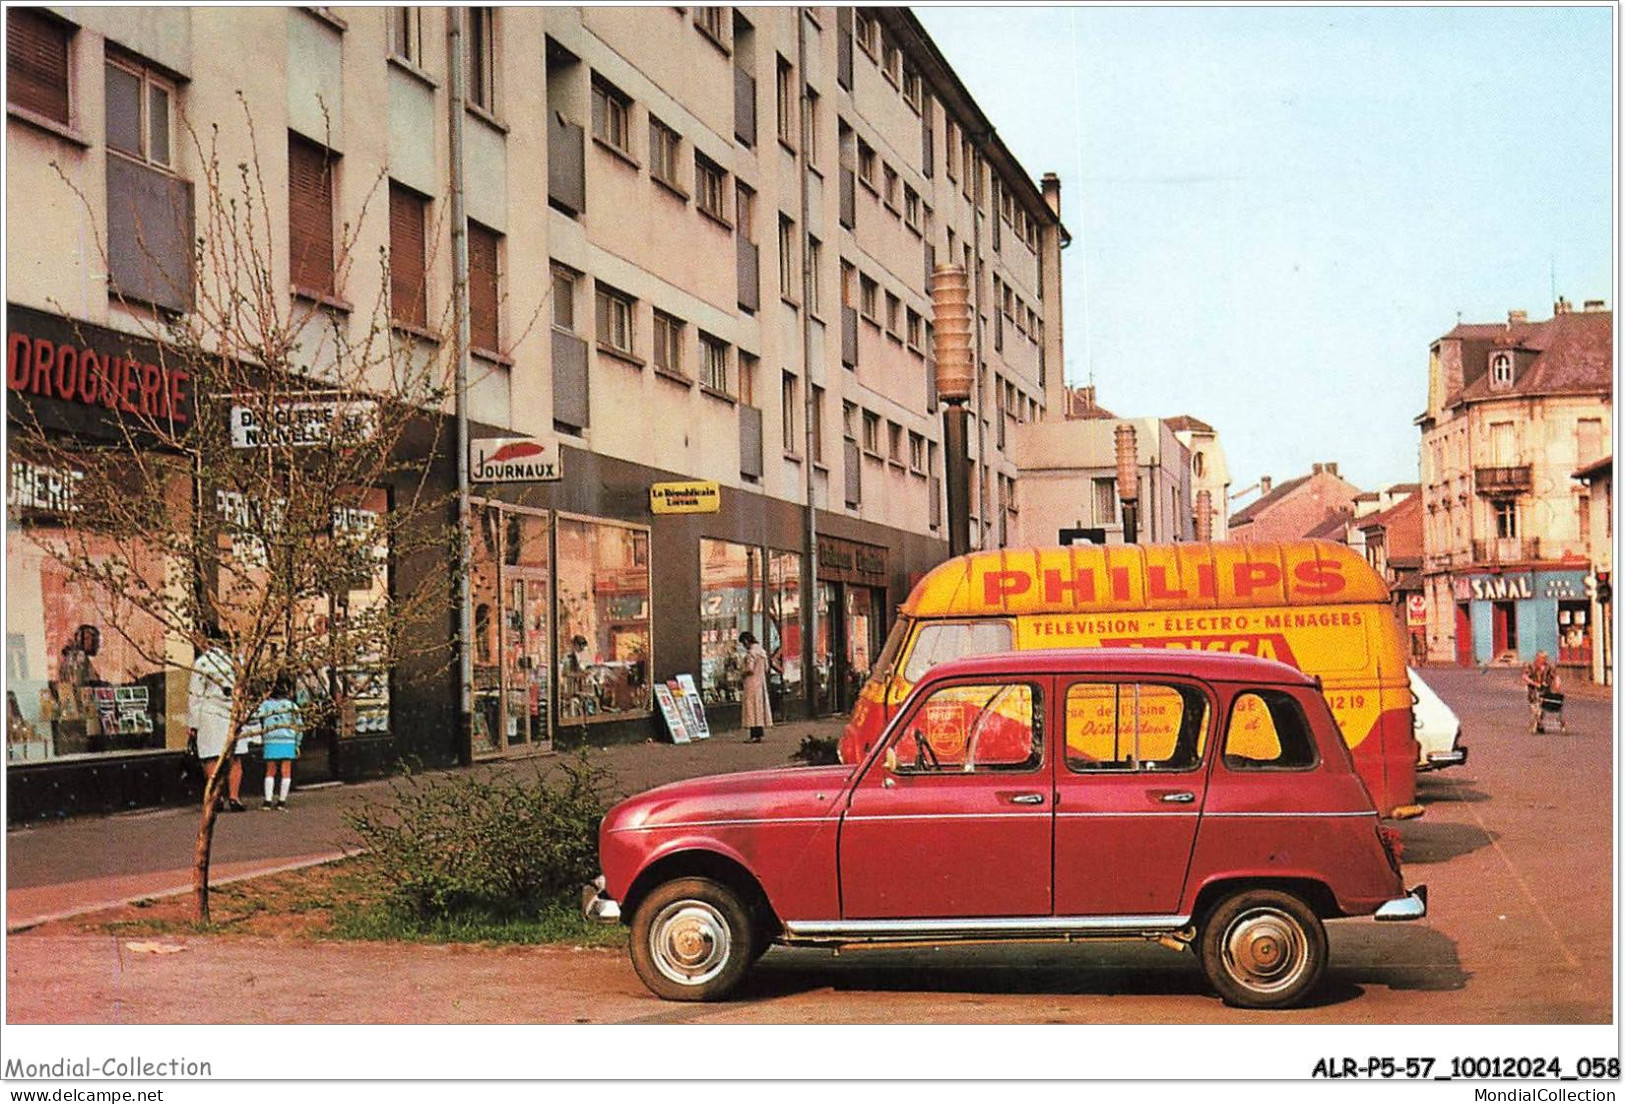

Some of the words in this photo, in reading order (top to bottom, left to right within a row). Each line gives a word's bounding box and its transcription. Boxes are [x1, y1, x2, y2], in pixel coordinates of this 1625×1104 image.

[7, 331, 190, 423] DROGUERIE
[240, 407, 334, 427] DGUERIE
[473, 449, 554, 479] JOURNAUX
[653, 488, 664, 498] Le
[984, 560, 1347, 605] PHILIPS
[1065, 708, 1085, 719] ue
[1097, 703, 1112, 717] de
[1330, 695, 1345, 709] 12
[1350, 694, 1365, 709] 19
